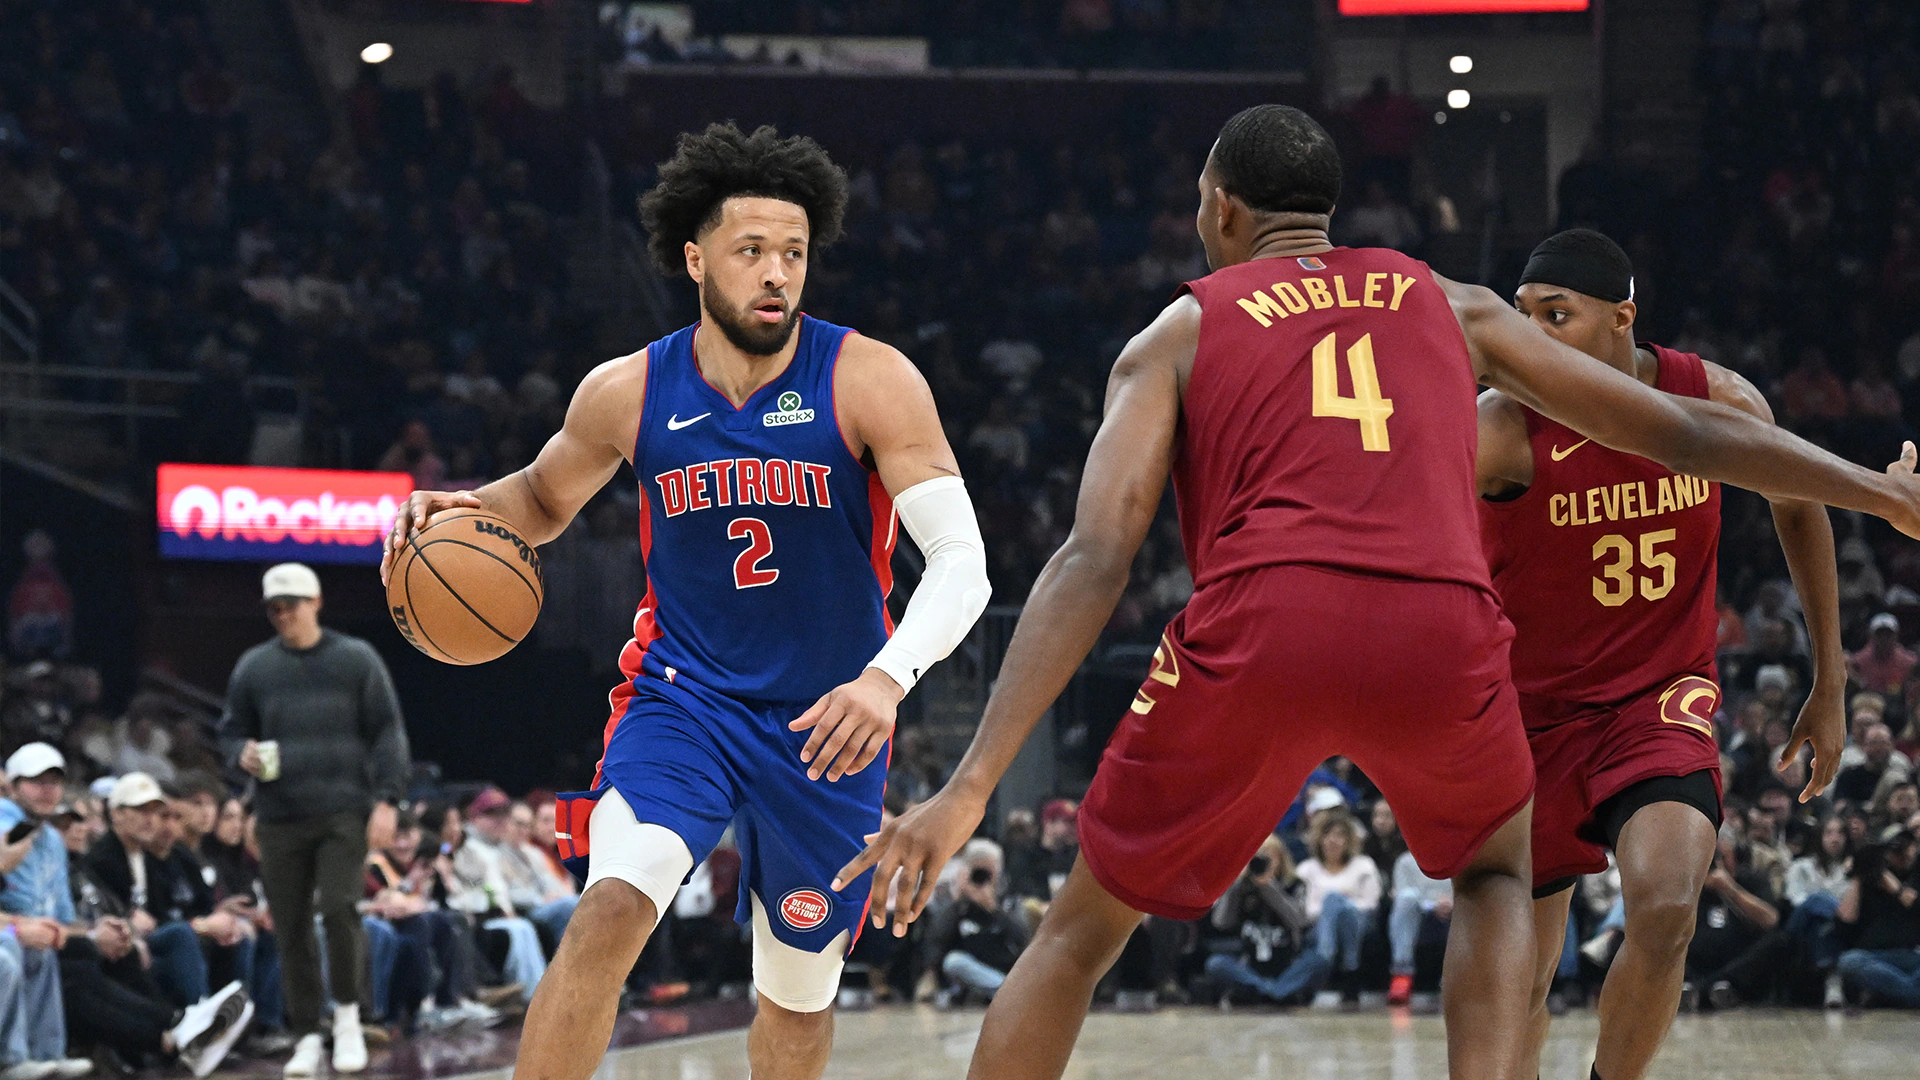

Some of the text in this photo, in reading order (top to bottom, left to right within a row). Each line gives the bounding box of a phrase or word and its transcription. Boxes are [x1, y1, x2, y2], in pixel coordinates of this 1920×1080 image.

[1236, 272, 1417, 328] MOBLEY
[765, 410, 813, 425] StockX
[1312, 332, 1394, 452] 4
[222, 486, 396, 546] Rocket
[655, 458, 831, 518] DETROIT
[1549, 474, 1710, 527] CLEVELAND
[727, 517, 780, 590] 2
[1592, 528, 1676, 607] 35
[787, 904, 819, 920] PISTONS
[791, 898, 823, 913] DETROIT
